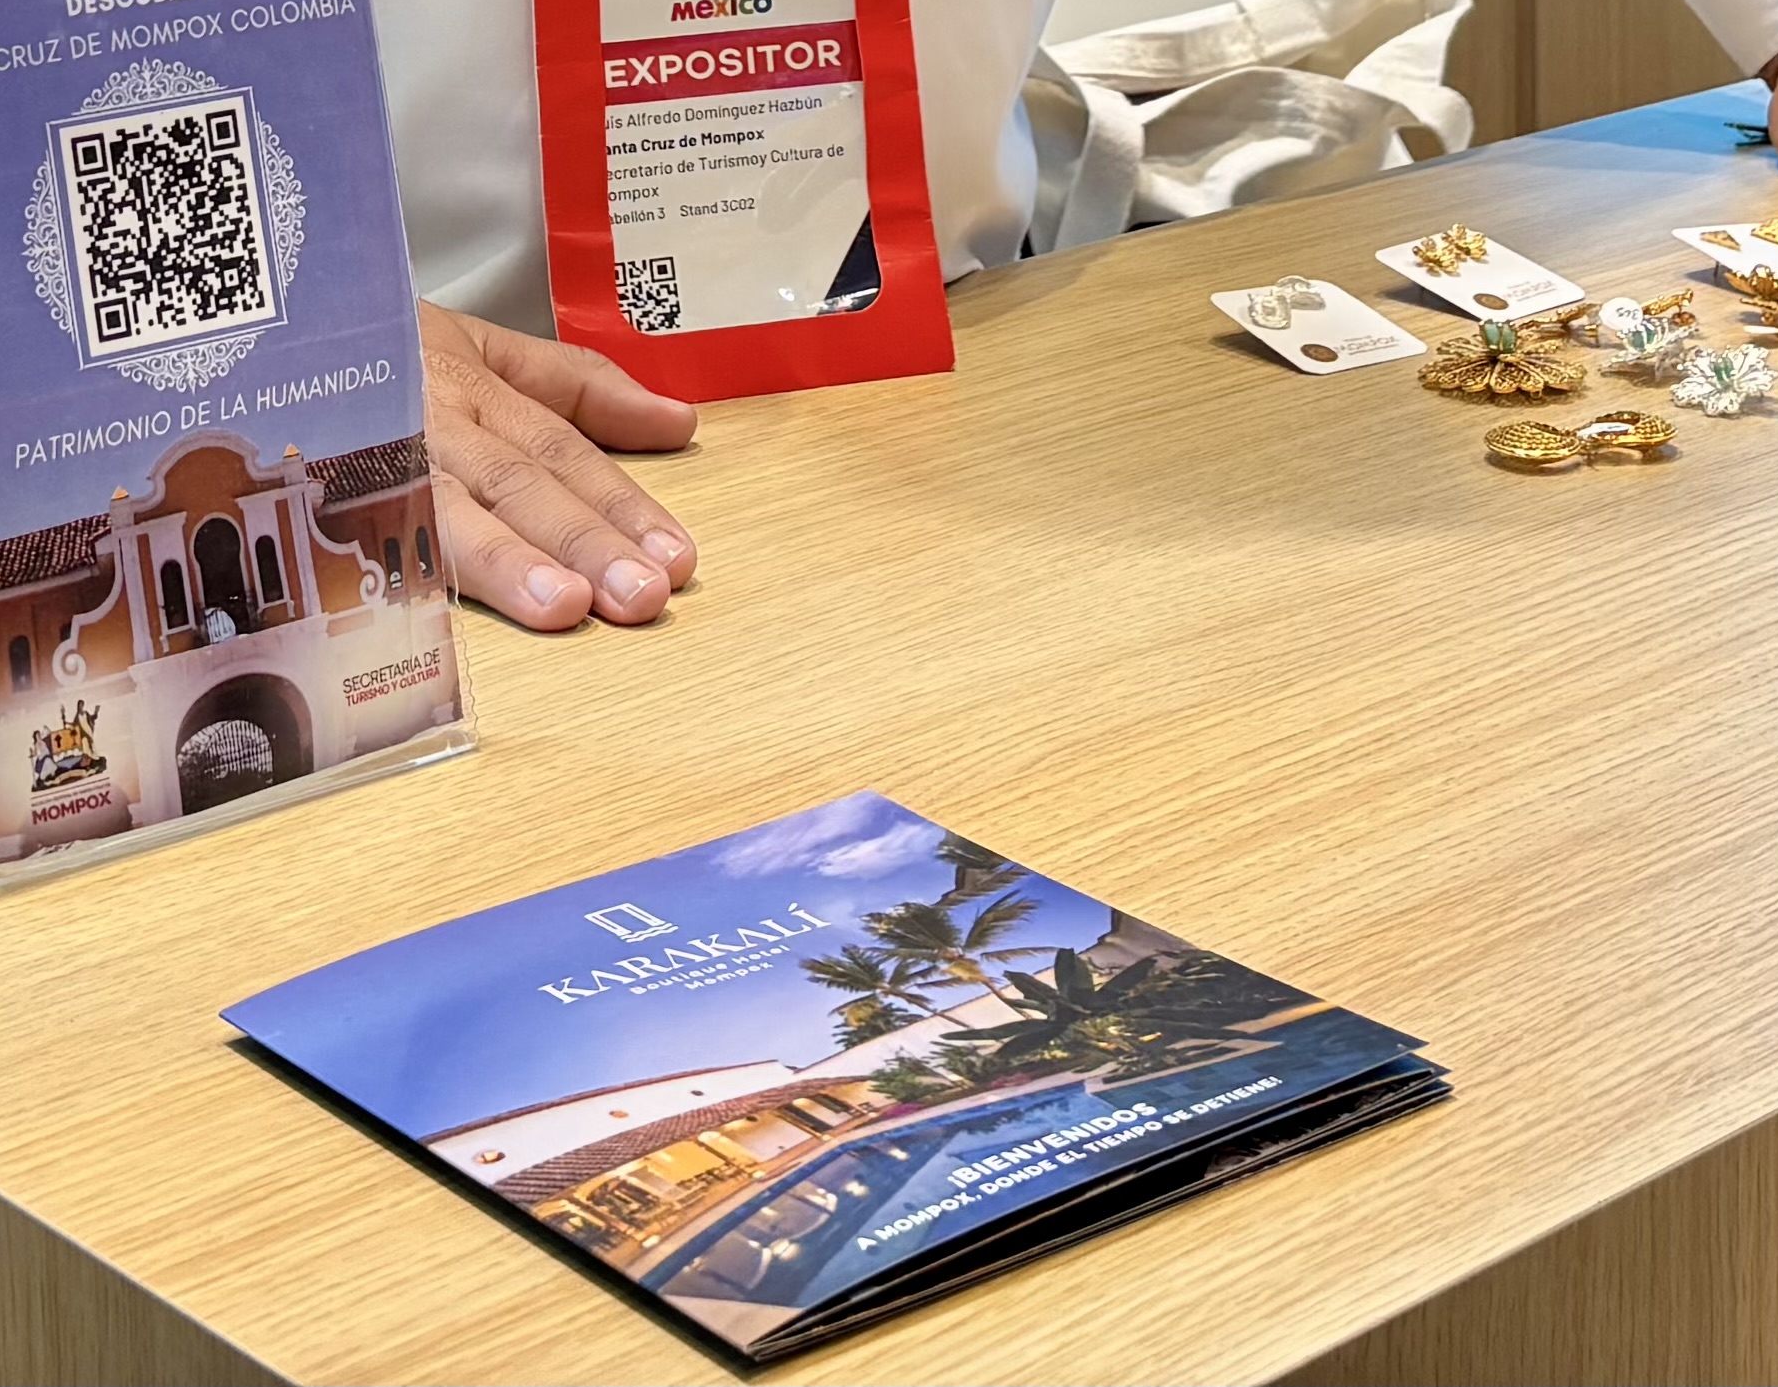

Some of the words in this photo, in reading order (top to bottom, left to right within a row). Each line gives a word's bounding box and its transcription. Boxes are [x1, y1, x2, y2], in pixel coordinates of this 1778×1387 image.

[69, 31, 103, 60] DE
[110, 12, 224, 53] MOMPOX
[604, 39, 841, 89] EXPOSITOR
[627, 109, 681, 128] Alfredo
[685, 103, 766, 122] Domínguez
[768, 96, 822, 114] Hazbún
[605, 142, 638, 156] anta
[641, 138, 676, 152] Cruz
[679, 134, 697, 148] de
[701, 129, 765, 147] Mompox
[607, 162, 673, 181] ecretario
[677, 160, 695, 174] de
[770, 146, 824, 164] Cultura
[827, 143, 845, 158] de
[608, 187, 660, 203] ompox
[657, 206, 666, 220] 3
[680, 202, 719, 217] Stand
[721, 197, 756, 213] 3C02
[14, 409, 171, 469] PATRIMONIO
[180, 400, 211, 429] DE
[220, 396, 248, 421] LA
[256, 359, 397, 412] HUMANIDAD.
[342, 653, 422, 694] SECRETARÍA
[423, 648, 441, 668] DE
[32, 790, 112, 825] MOMPOX
[537, 902, 832, 1004] KARAKALÍ
[629, 962, 728, 995] Boutique
[731, 944, 791, 966] Hotel
[684, 961, 774, 990] Mompox
[855, 1235, 877, 1252] A
[874, 1191, 982, 1242] MOMPOX,
[983, 1158, 1058, 1195] DONDE
[1058, 1148, 1088, 1167] EL
[1084, 1120, 1163, 1154] TIEMPO
[1161, 1108, 1191, 1126] SE
[1189, 1074, 1283, 1117] DETIENE!
[946, 1101, 1158, 1189] ¡BIENVENIDOS
